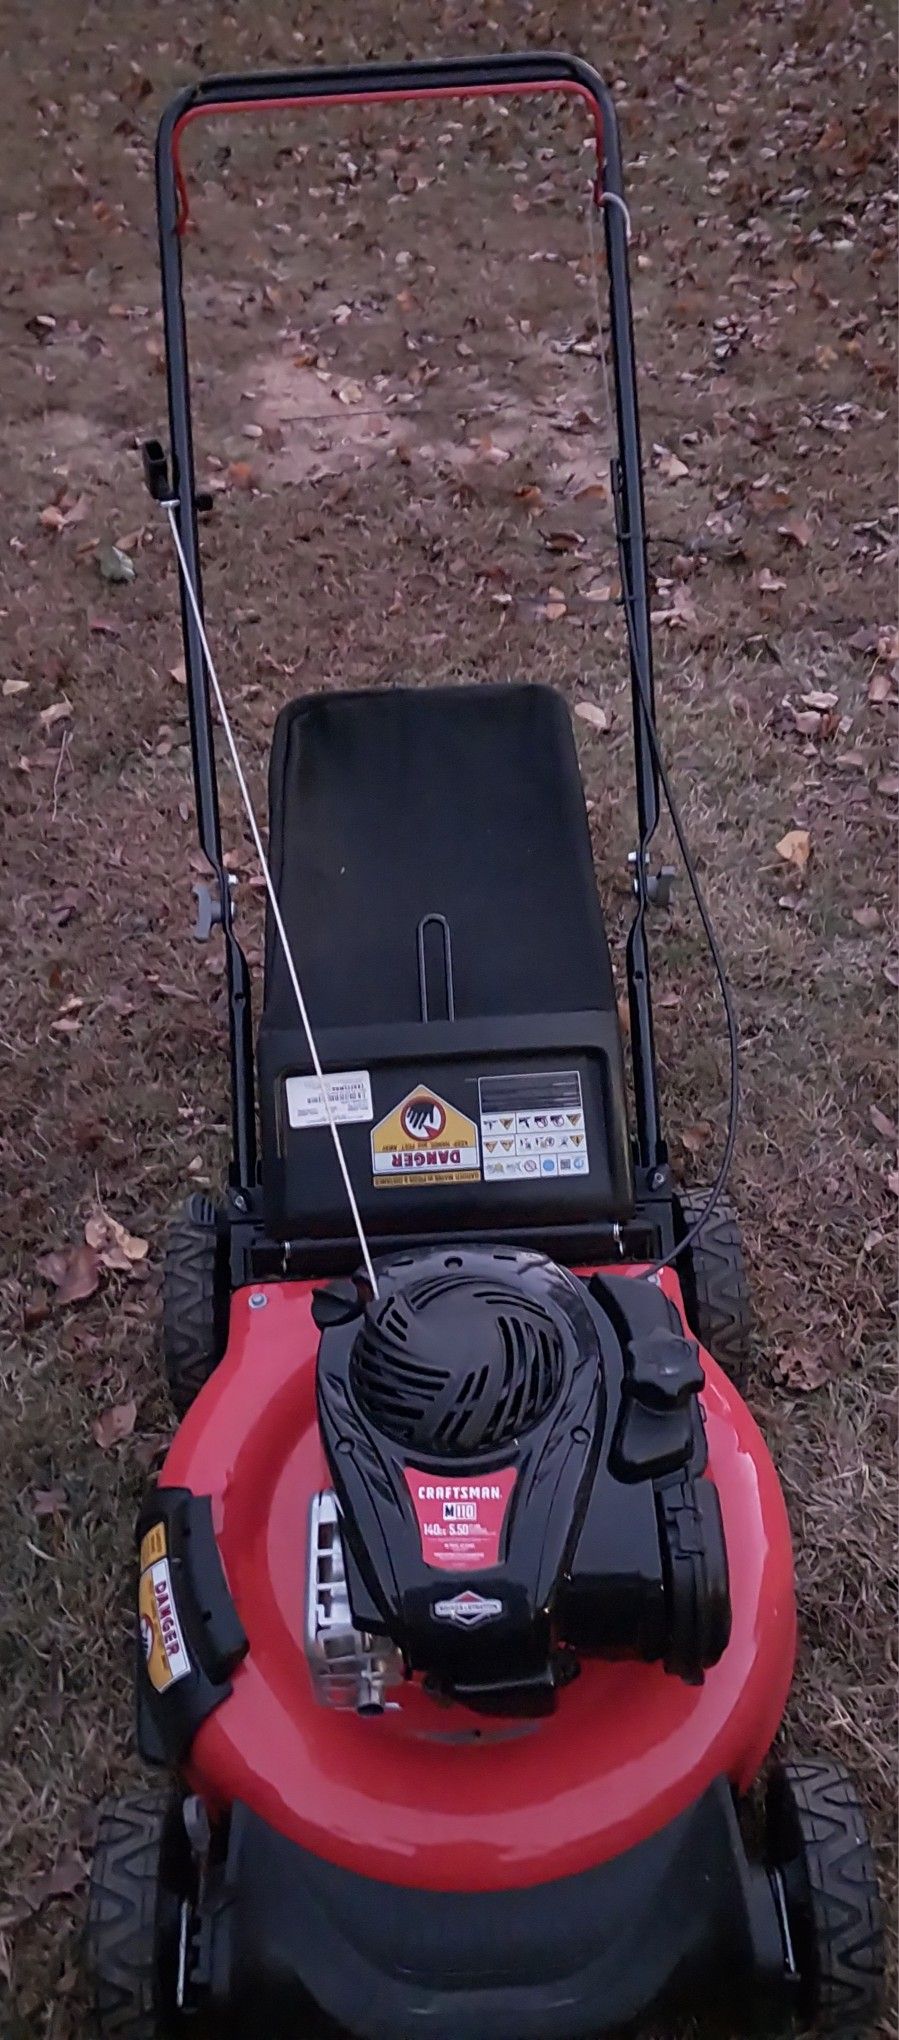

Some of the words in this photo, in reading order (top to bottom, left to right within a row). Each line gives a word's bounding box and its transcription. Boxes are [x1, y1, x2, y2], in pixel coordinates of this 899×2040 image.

[392, 1149, 461, 1168] DANGER
[418, 1486, 501, 1500] CRAFTSMAN
[155, 1580, 180, 1657] DANGER
